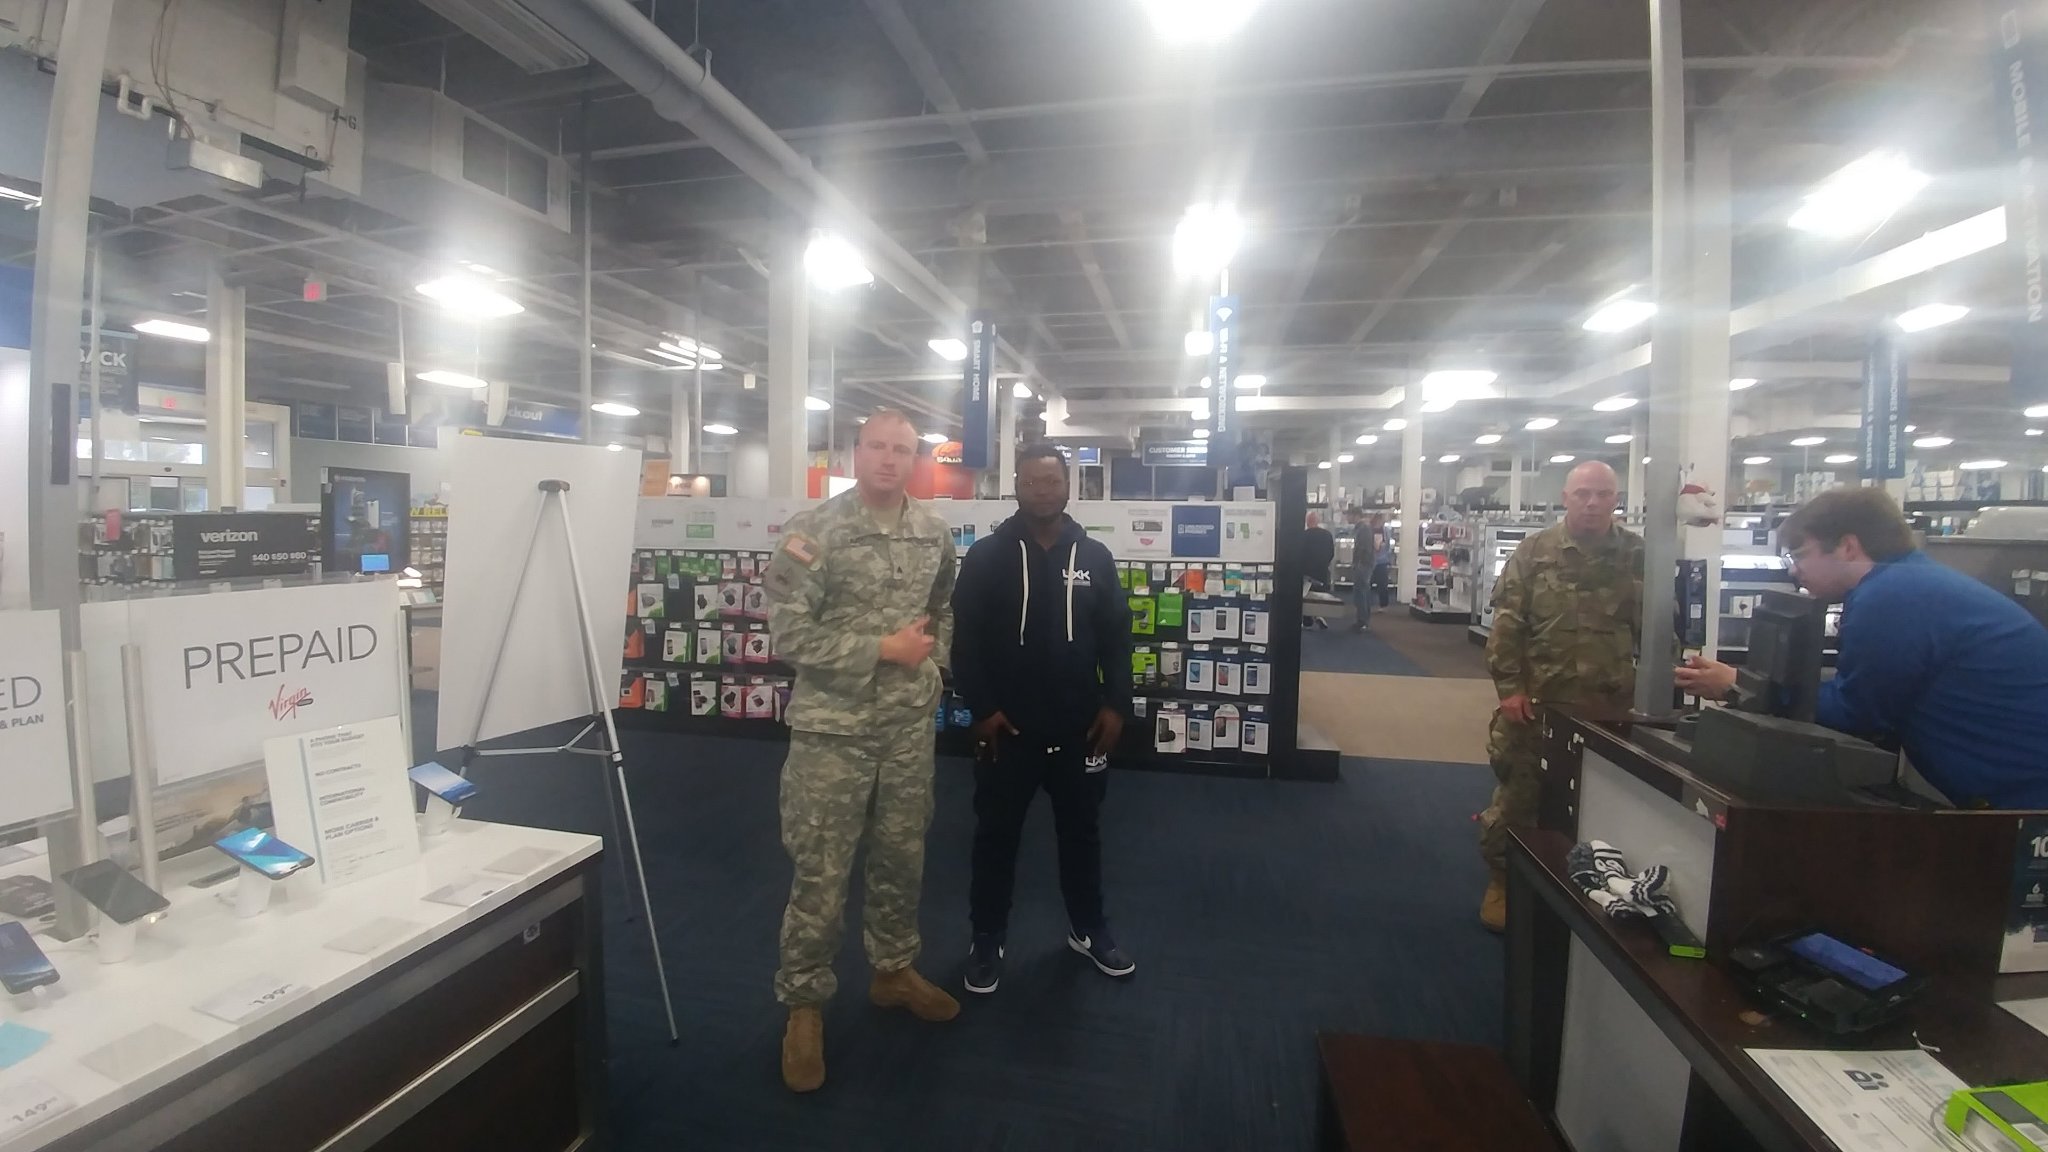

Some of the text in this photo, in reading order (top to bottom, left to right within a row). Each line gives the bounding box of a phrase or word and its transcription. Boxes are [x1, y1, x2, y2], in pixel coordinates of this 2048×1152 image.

[2008, 59, 2031, 149] MOBILE
[972, 339, 981, 401] SMART HOME
[1218, 366, 1227, 432] NETWORKING
[1148, 446, 1186, 454] CUSTOMER
[1887, 424, 1898, 470] SPEAKERS
[200, 529, 258, 543] verizon
[183, 624, 378, 689] PREPAID
[268, 683, 312, 720] Virgin
[11, 713, 44, 728] PLAN
[324, 824, 345, 835] MORE
[325, 822, 374, 841] PLAN OPTIONS
